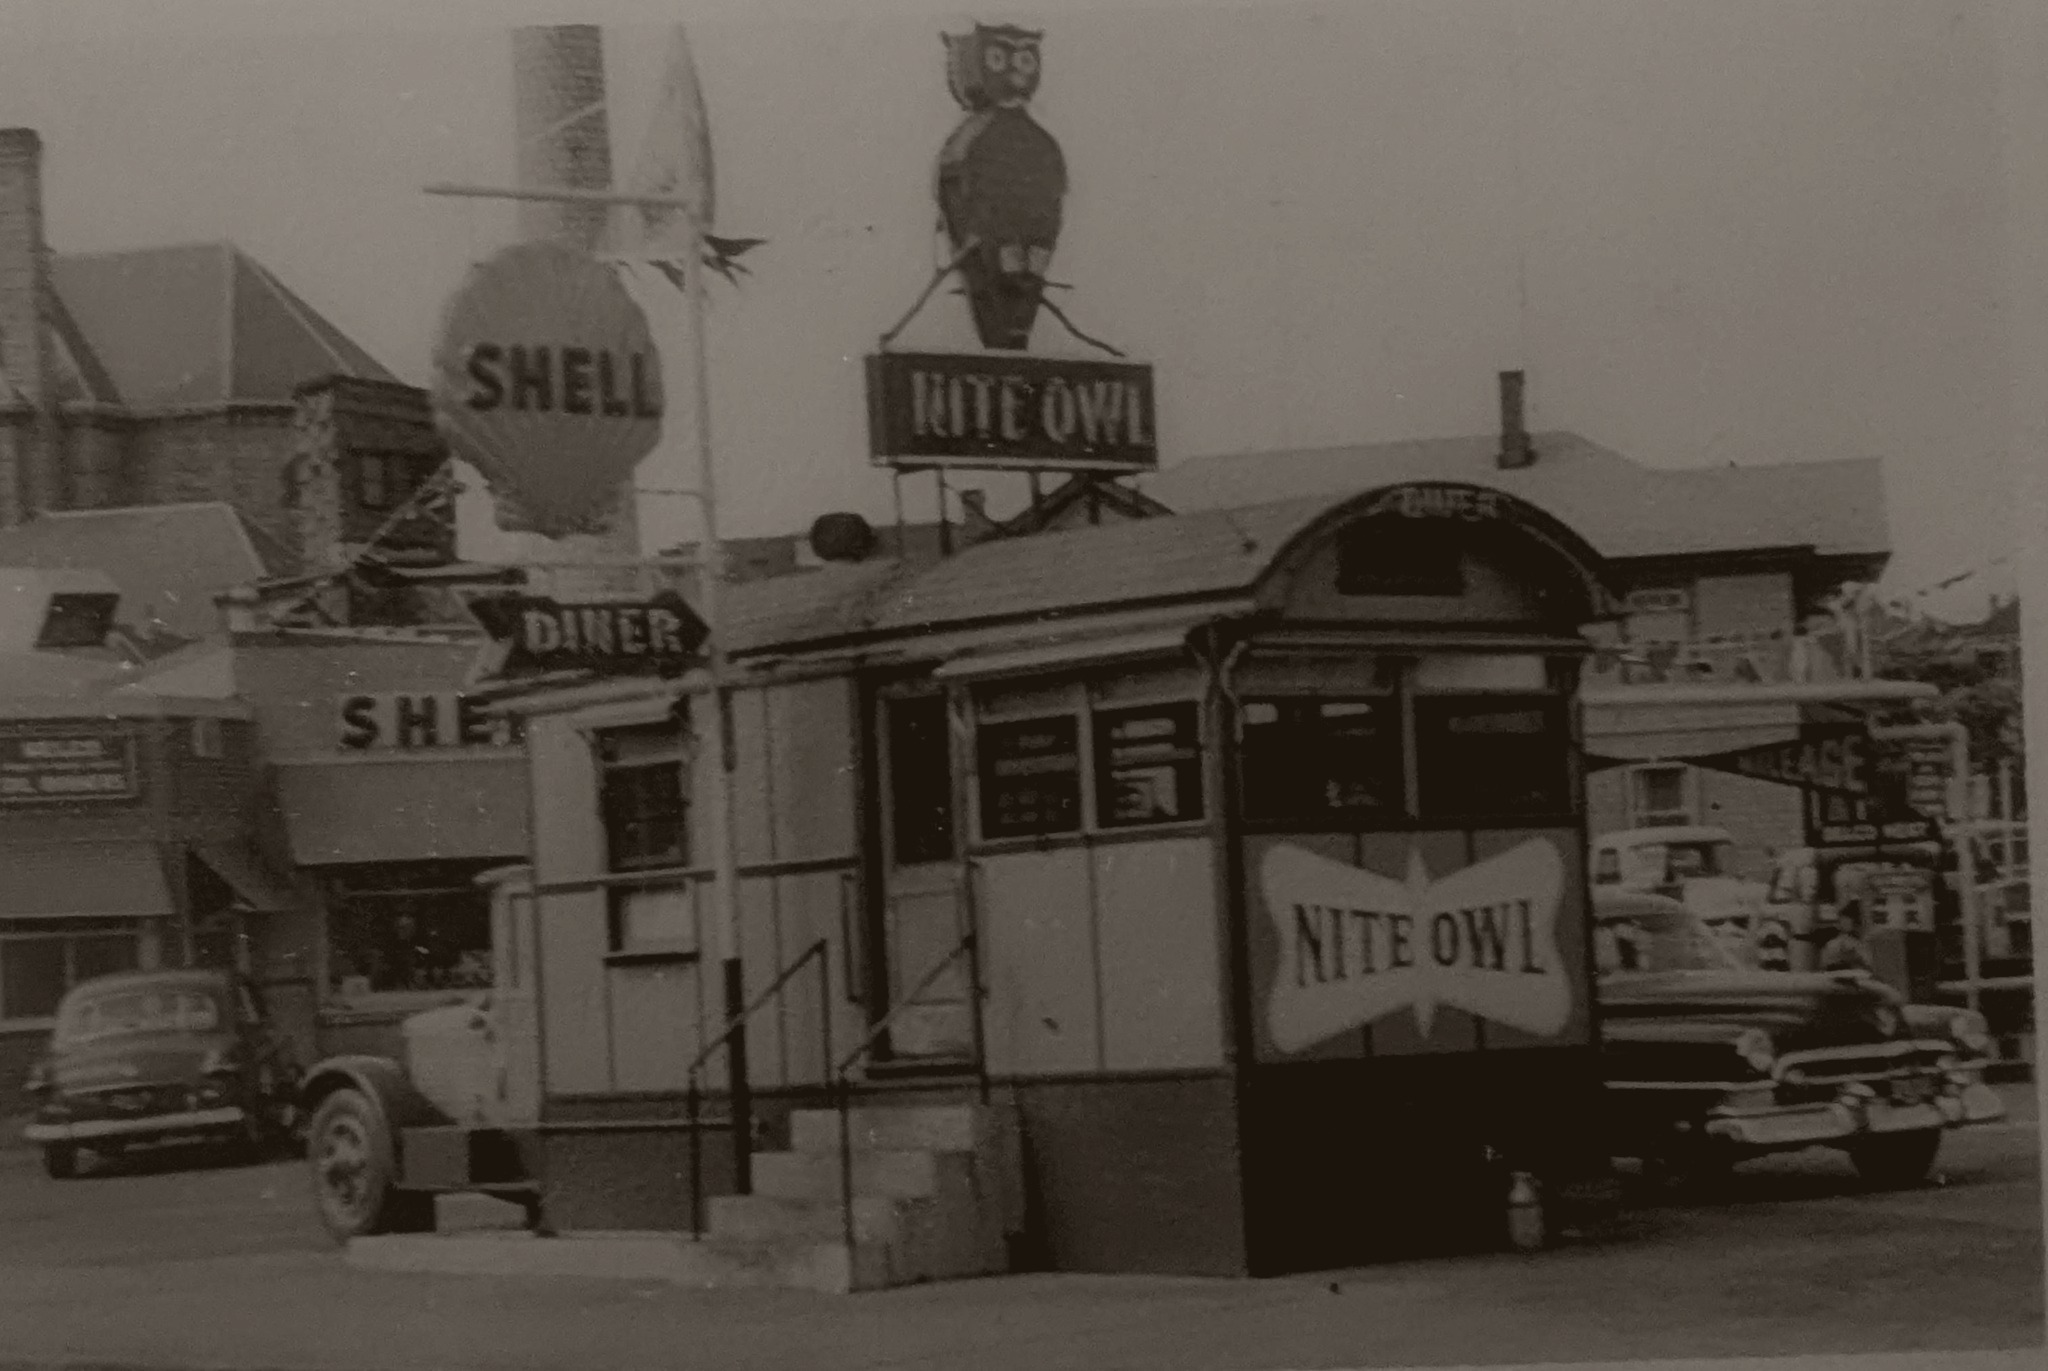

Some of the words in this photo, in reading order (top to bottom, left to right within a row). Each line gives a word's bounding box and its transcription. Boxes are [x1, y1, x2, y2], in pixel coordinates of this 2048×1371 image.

[468, 343, 660, 418] SHELL
[911, 368, 1026, 441] NITE
[1041, 375, 1155, 446] OWL
[523, 606, 683, 655] DINER
[1293, 903, 1414, 988] NITE
[1433, 897, 1548, 975] OWL
